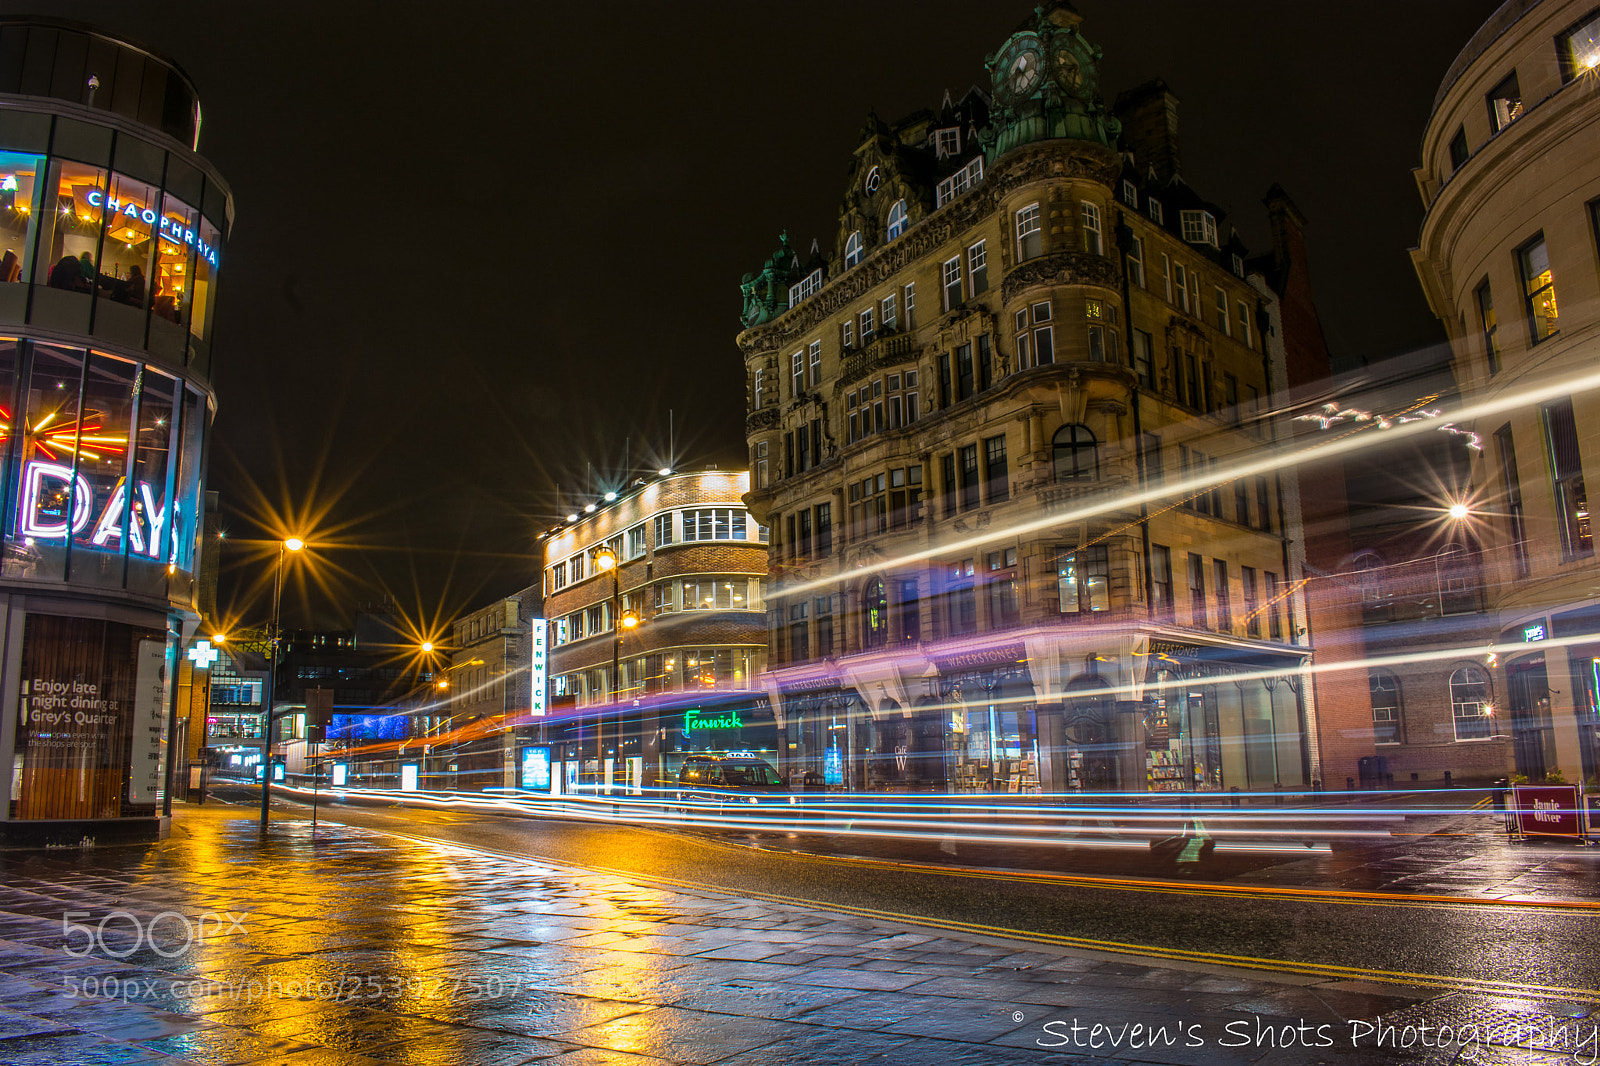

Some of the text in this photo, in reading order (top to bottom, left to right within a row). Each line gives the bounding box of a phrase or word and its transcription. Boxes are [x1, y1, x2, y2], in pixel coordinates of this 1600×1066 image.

[87, 191, 216, 265] CHAOPHRAYA
[946, 647, 1019, 667] WATERSTONES
[534, 625, 544, 710] FENWICK
[33, 679, 97, 695] Enjoy late
[31, 694, 118, 712] night dining at
[756, 699, 767, 708] W
[30, 710, 117, 726] Grey's Quarter
[682, 709, 743, 735] Fenwick
[43, 740, 65, 749] shops
[79, 740, 97, 748] shut
[895, 755, 907, 771] W
[1533, 798, 1560, 810] Jamie
[1534, 810, 1562, 823] Oliver
